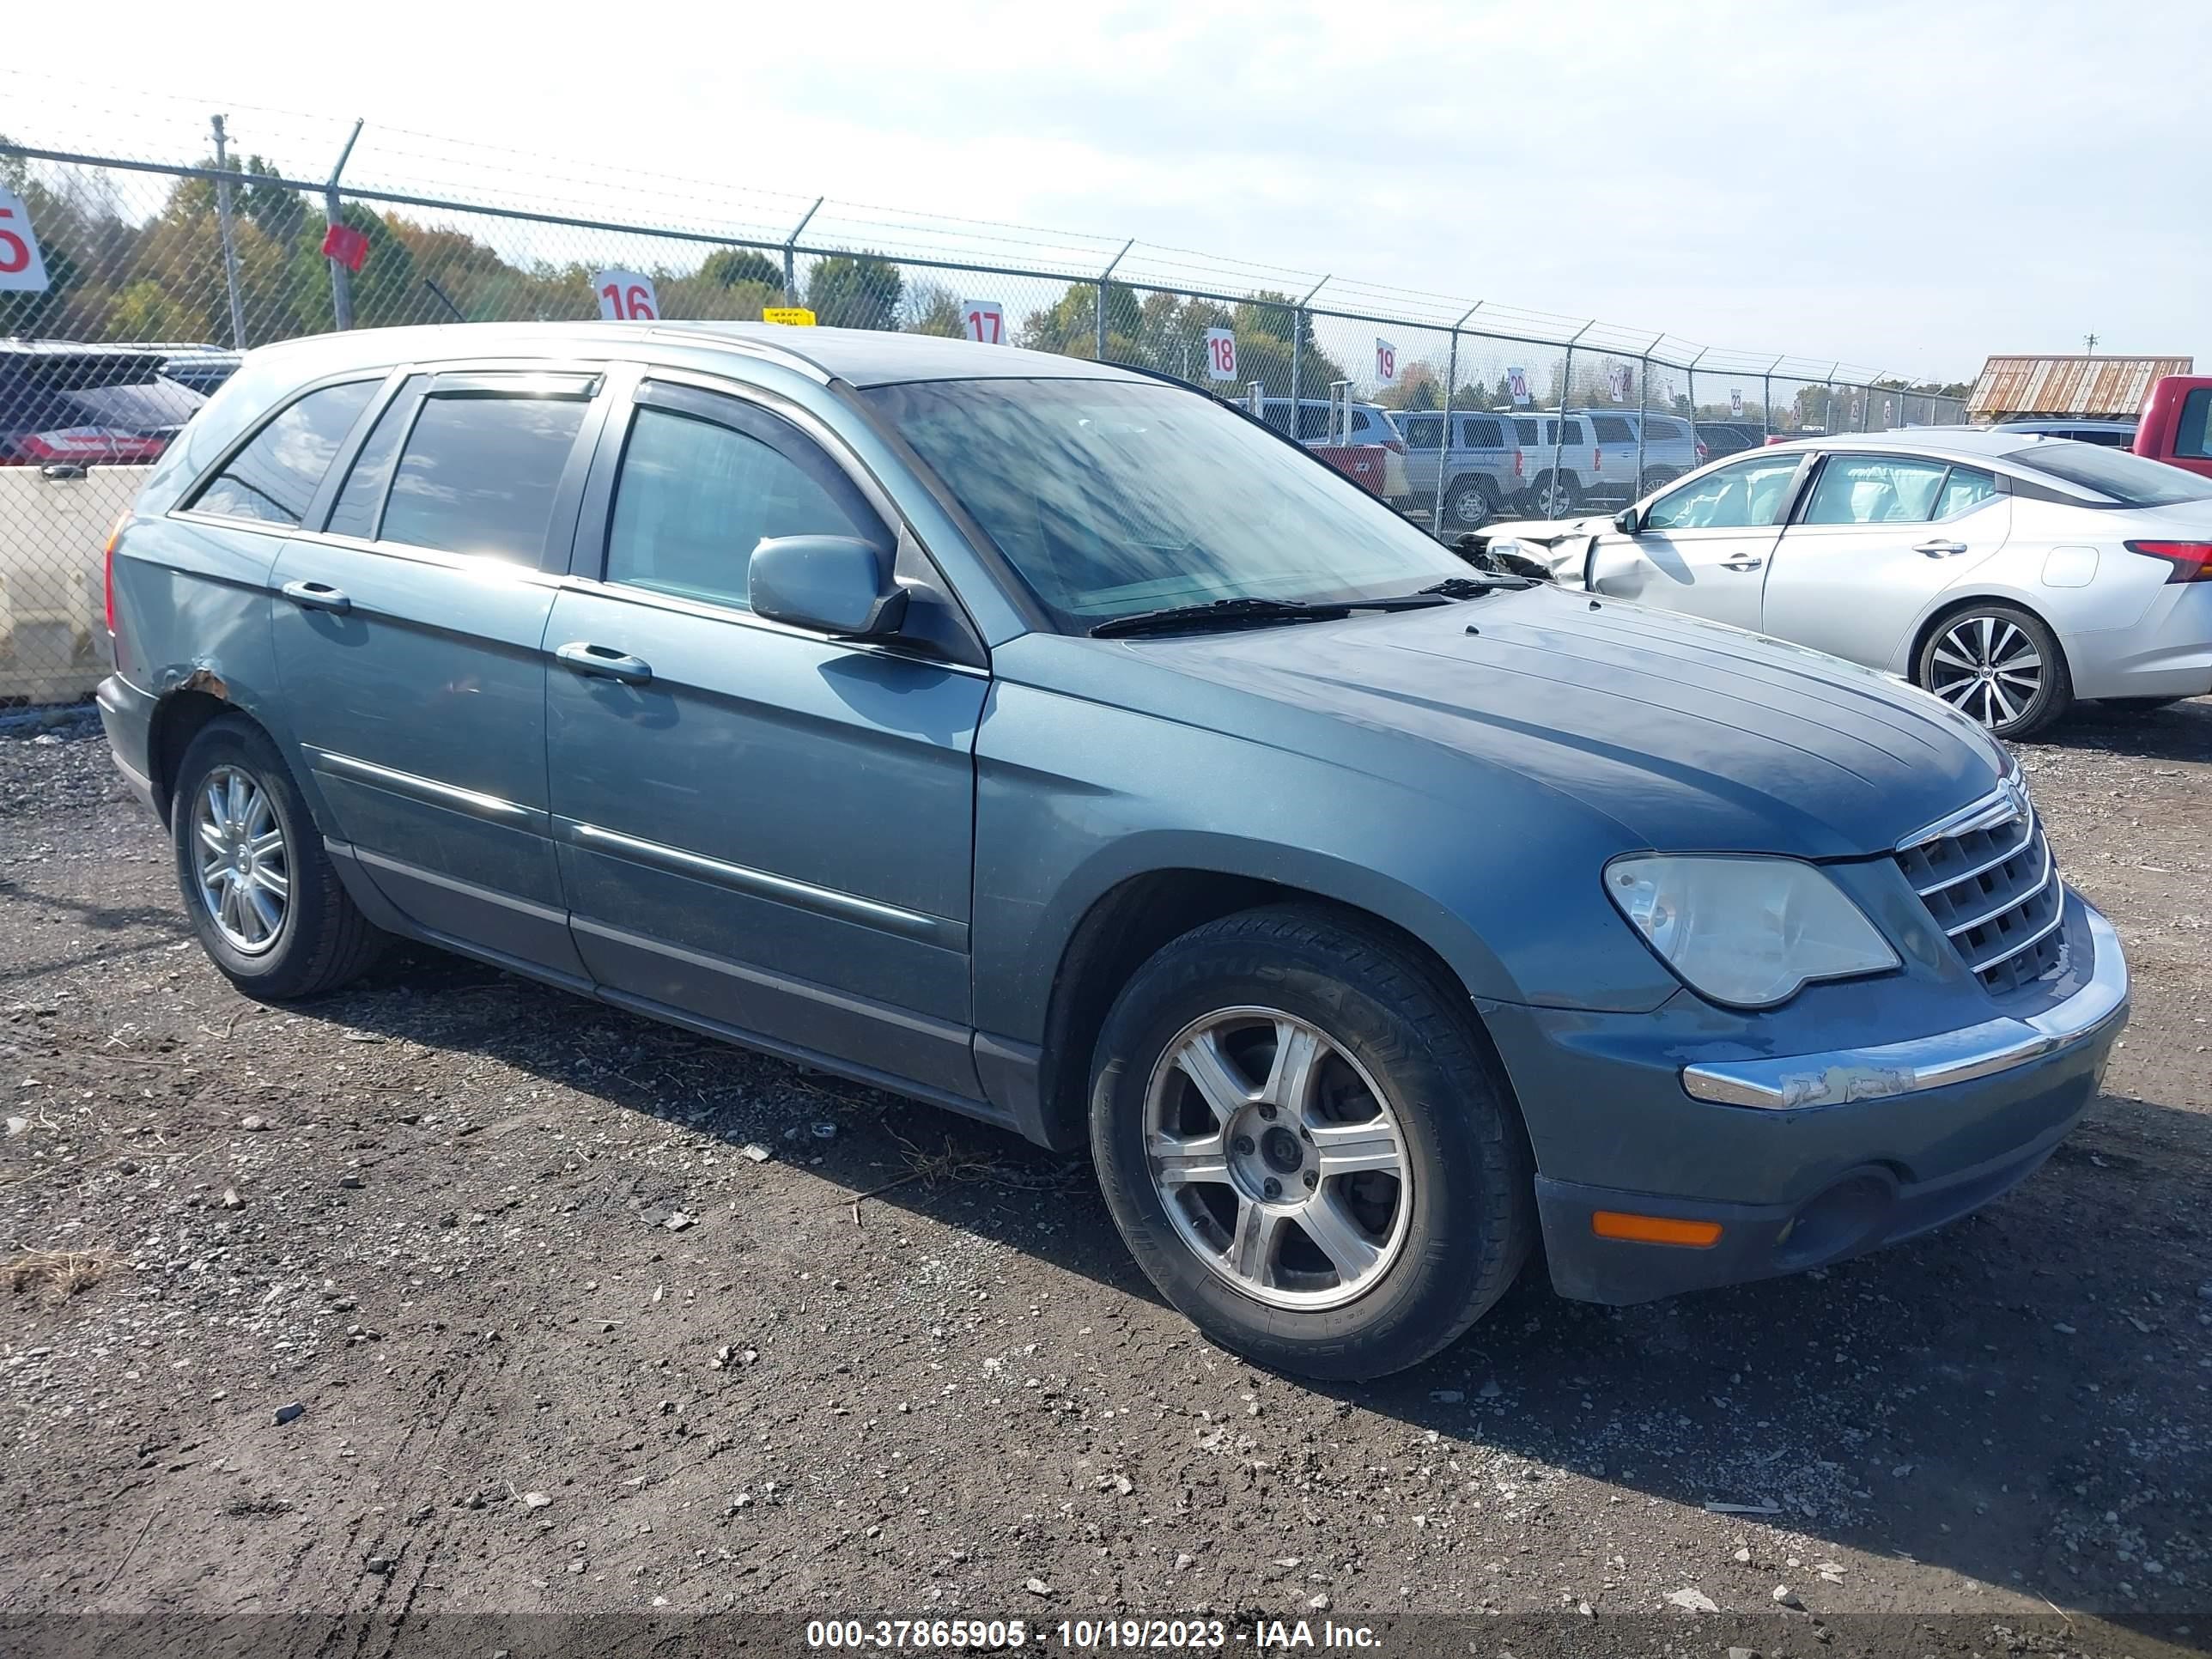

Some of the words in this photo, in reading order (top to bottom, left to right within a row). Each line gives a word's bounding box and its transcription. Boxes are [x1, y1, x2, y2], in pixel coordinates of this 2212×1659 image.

[603, 283, 654, 320] 16
[969, 312, 1000, 344] 17
[1209, 337, 1234, 373] 18
[1377, 347, 1394, 379] 19
[1511, 374, 1527, 397] 20
[1732, 394, 1741, 411] 23
